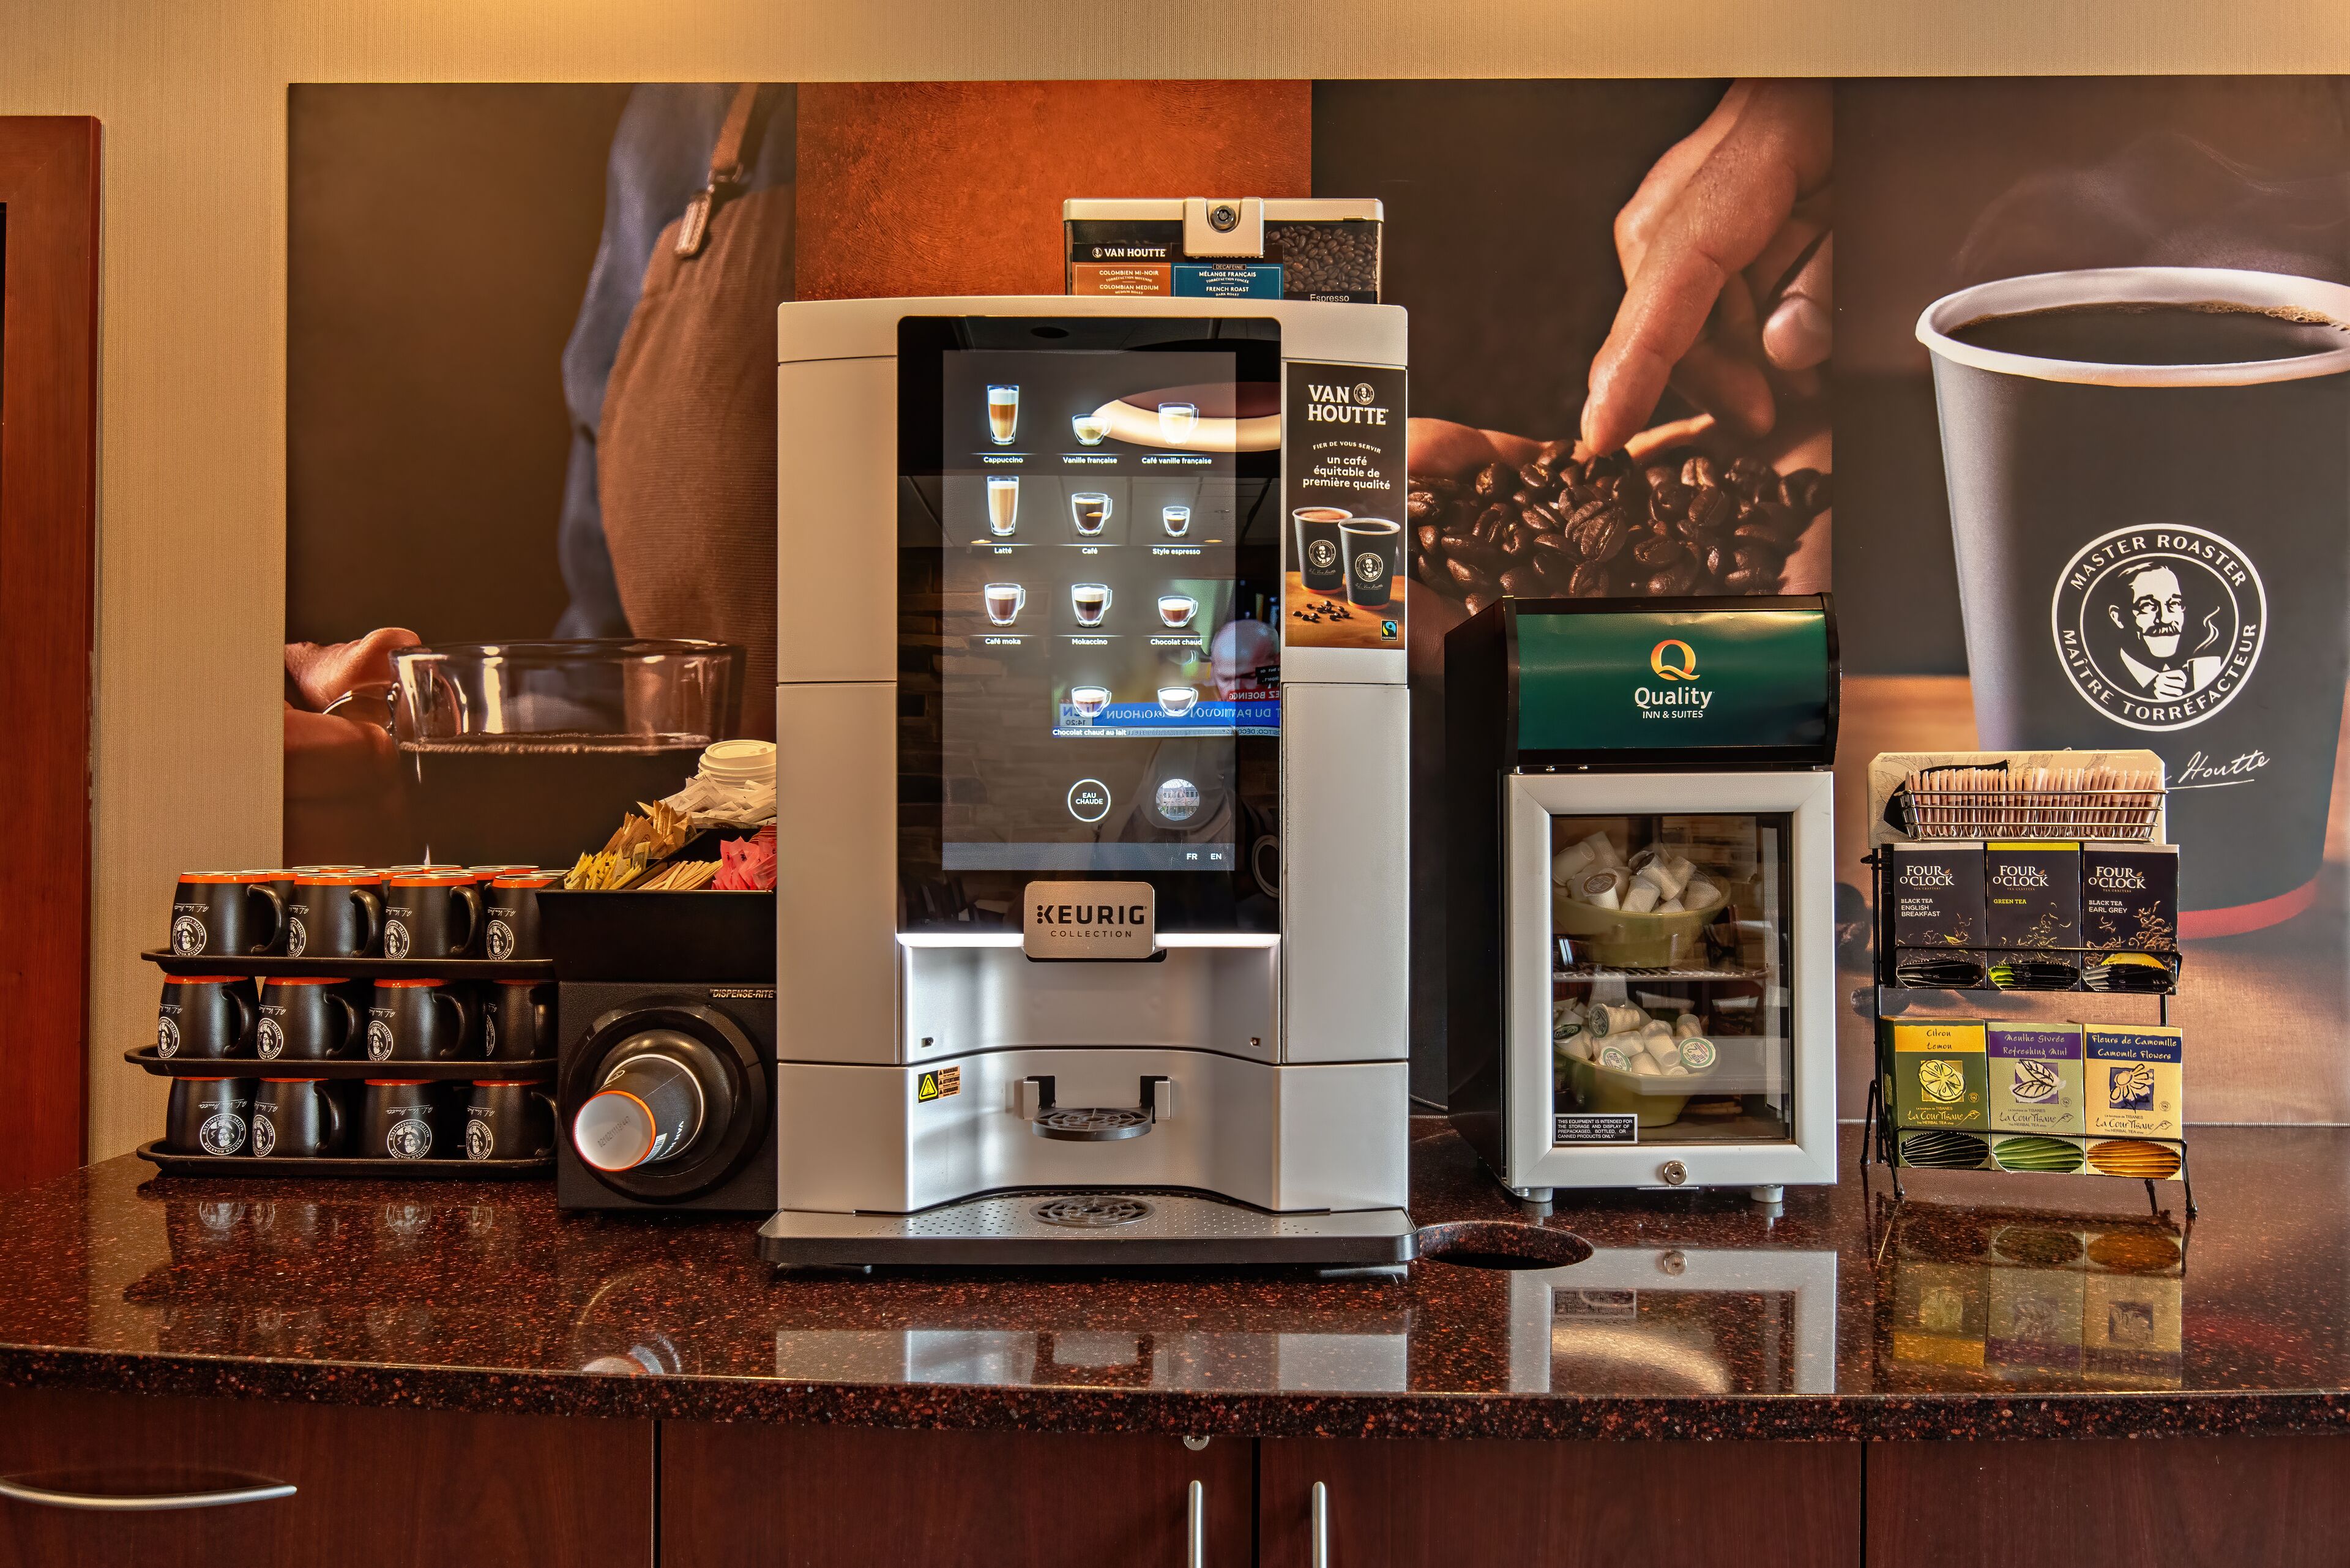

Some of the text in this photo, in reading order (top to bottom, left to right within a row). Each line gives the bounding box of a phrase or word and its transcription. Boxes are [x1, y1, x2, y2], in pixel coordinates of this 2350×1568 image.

[1104, 248, 1166, 257] VAN HOUTTE
[1309, 294, 1349, 303] Espresso
[1308, 384, 1349, 403] VAN
[1308, 404, 1387, 425] HOUTTE
[1313, 441, 1327, 450] FIER
[1359, 442, 1381, 454] SERVIR
[983, 456, 1023, 465] Cappuccino
[1087, 456, 1117, 465] française
[1327, 456, 1367, 466] un café
[1313, 465, 1380, 478] équitable de
[1303, 477, 1390, 490] première qualité
[2070, 534, 2247, 590] MASTER ROASTER
[2063, 624, 2256, 721] MAÎTRE TORRÉFACTEUR
[1635, 687, 1712, 709] Quality
[1671, 710, 1703, 719] SUITES
[2177, 750, 2270, 783] Houtte
[1906, 865, 1951, 876] FOUR
[1999, 865, 2044, 877] FOUR
[2096, 866, 2142, 879] FOUR
[1900, 876, 1955, 886] O'CLOCK
[1993, 876, 2050, 887] O'CLOCK
[2088, 877, 2147, 889] O'CLOCK
[1037, 905, 1144, 925] KEURIG
[1927, 1028, 1951, 1037] Citron
[2004, 1034, 2065, 1043] Menthe Givrée
[2092, 1034, 2177, 1047] Fleurs de Camomille
[2003, 1046, 2068, 1058] Refreshing Mint
[2097, 1048, 2171, 1060] Camomile Flowers
[1908, 1110, 1919, 1121] La
[1999, 1111, 2010, 1121] La
[2095, 1118, 2107, 1127] La
